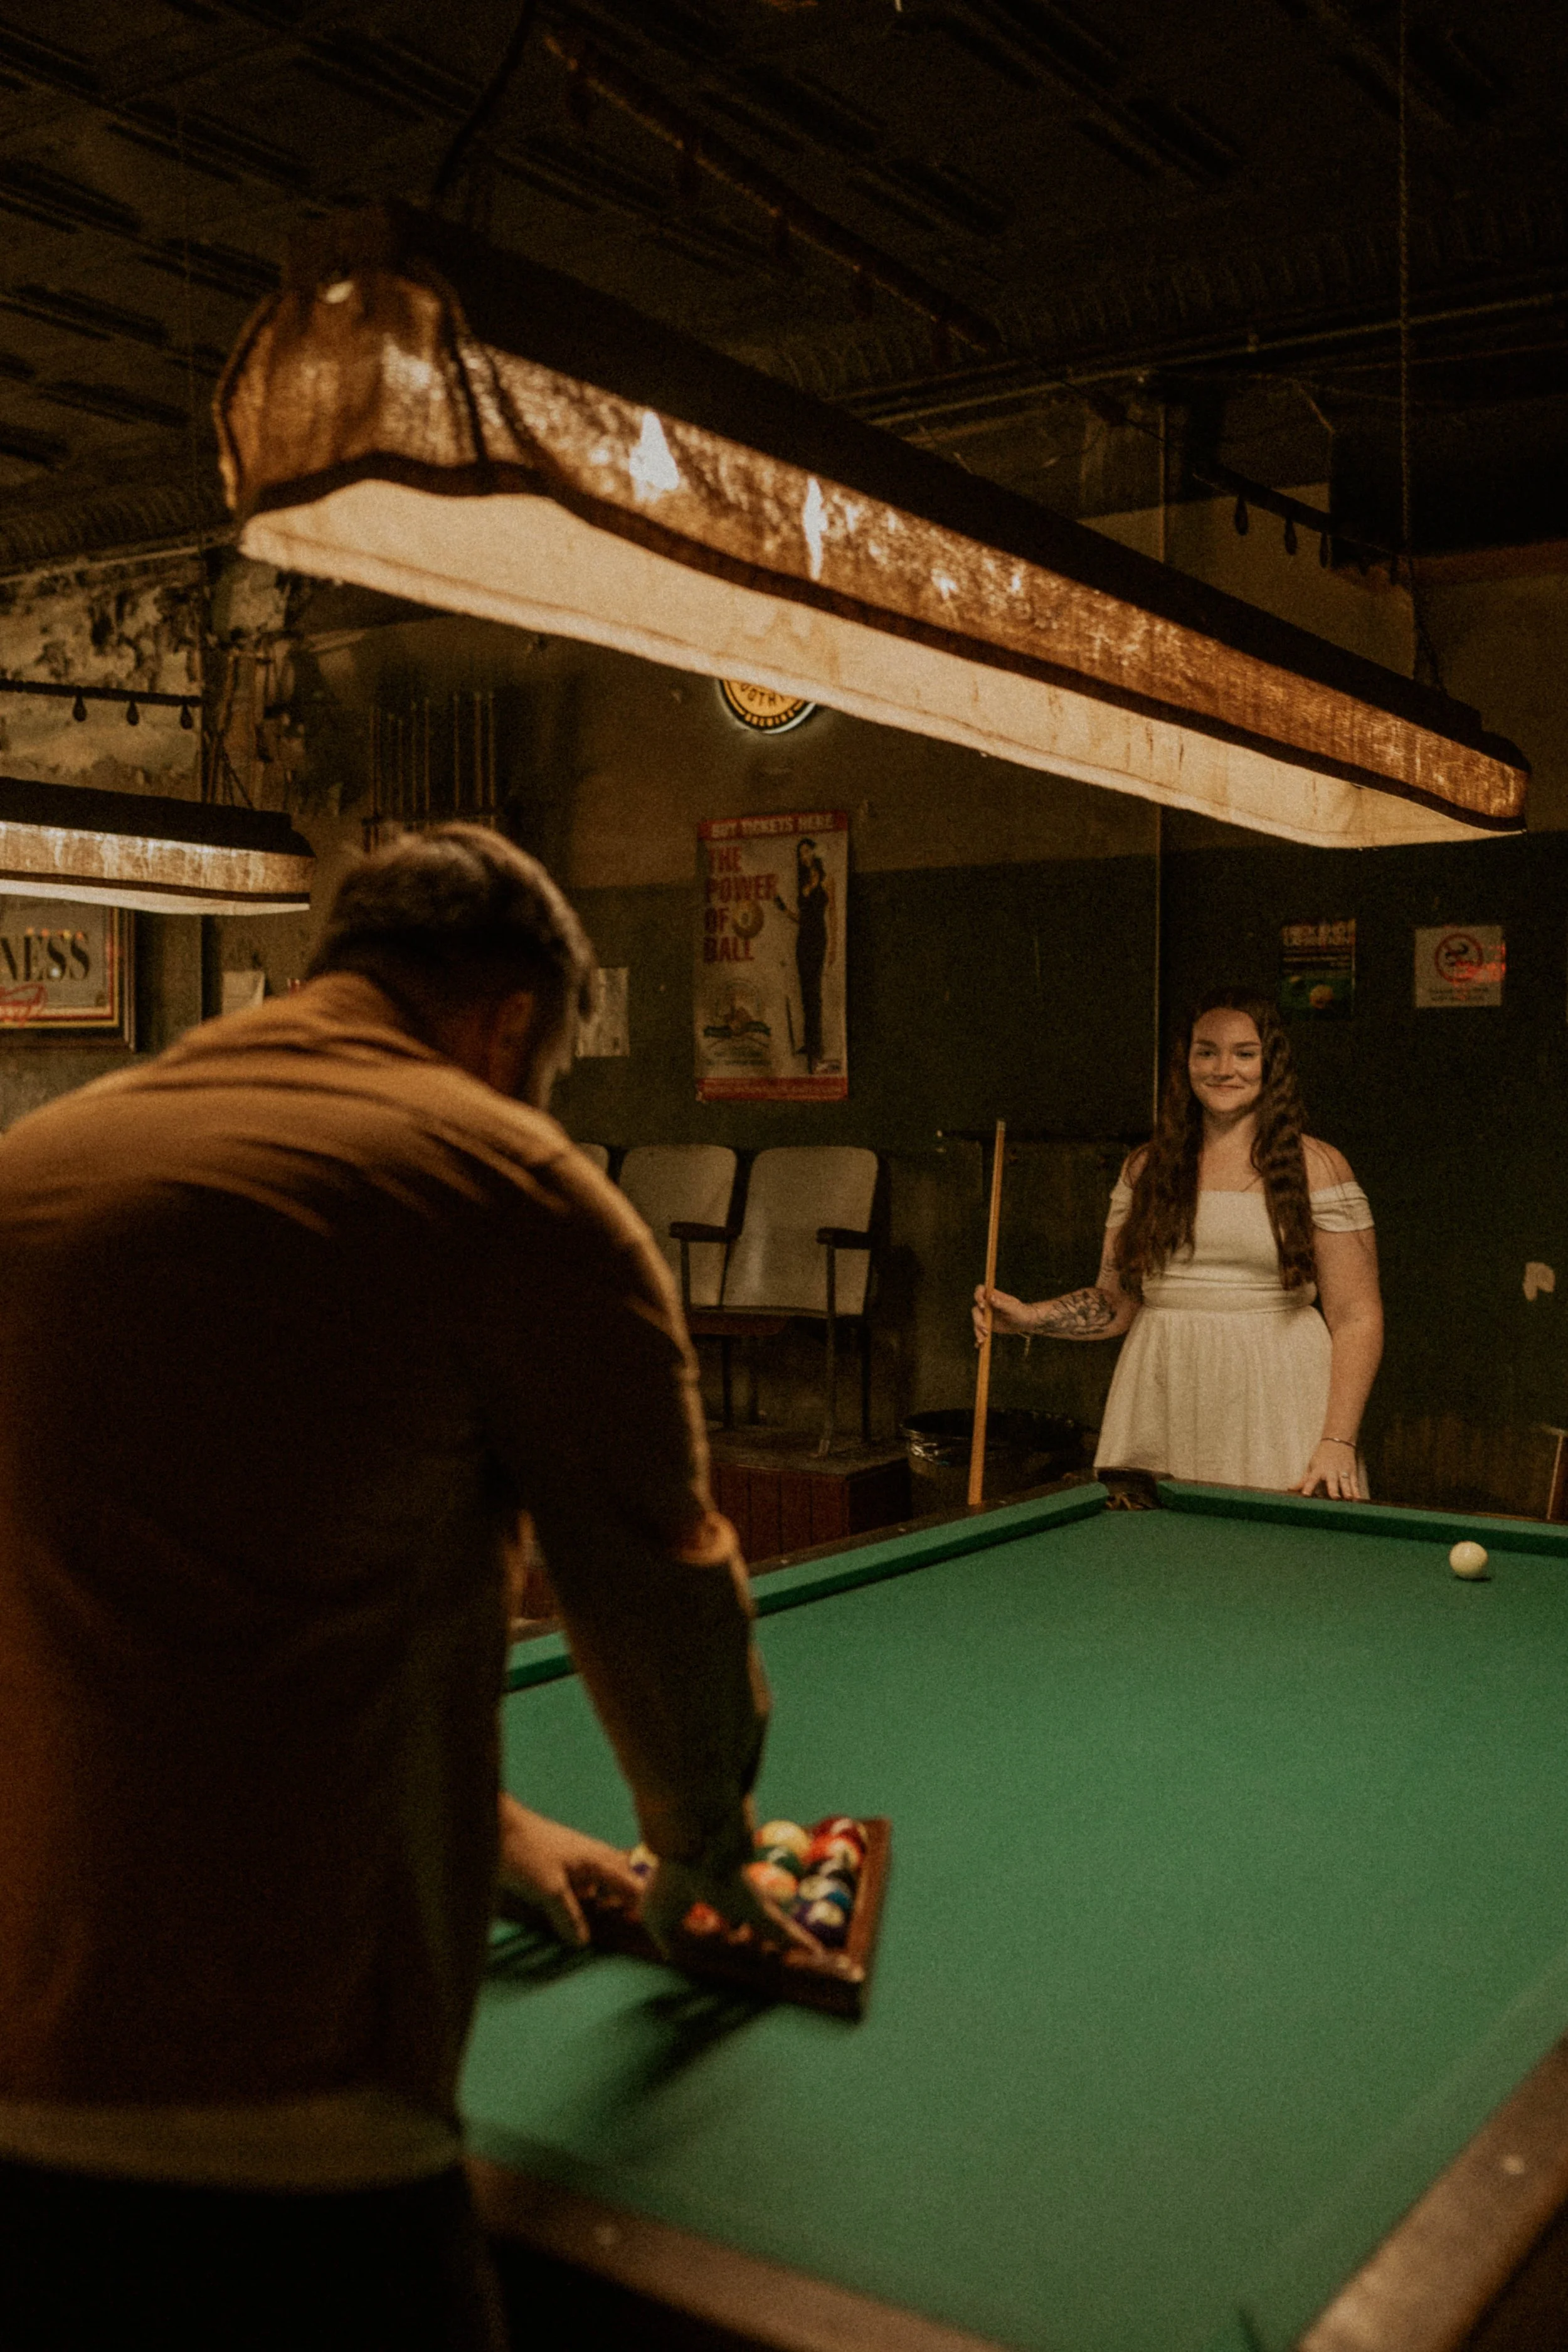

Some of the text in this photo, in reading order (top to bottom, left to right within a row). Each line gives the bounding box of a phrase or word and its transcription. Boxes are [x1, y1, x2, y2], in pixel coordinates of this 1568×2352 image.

[711, 813, 834, 839] BUY TICKETS HERE
[709, 847, 741, 872] THE
[704, 873, 778, 902] POWER
[704, 907, 729, 933] OF
[703, 936, 755, 963] BALL
